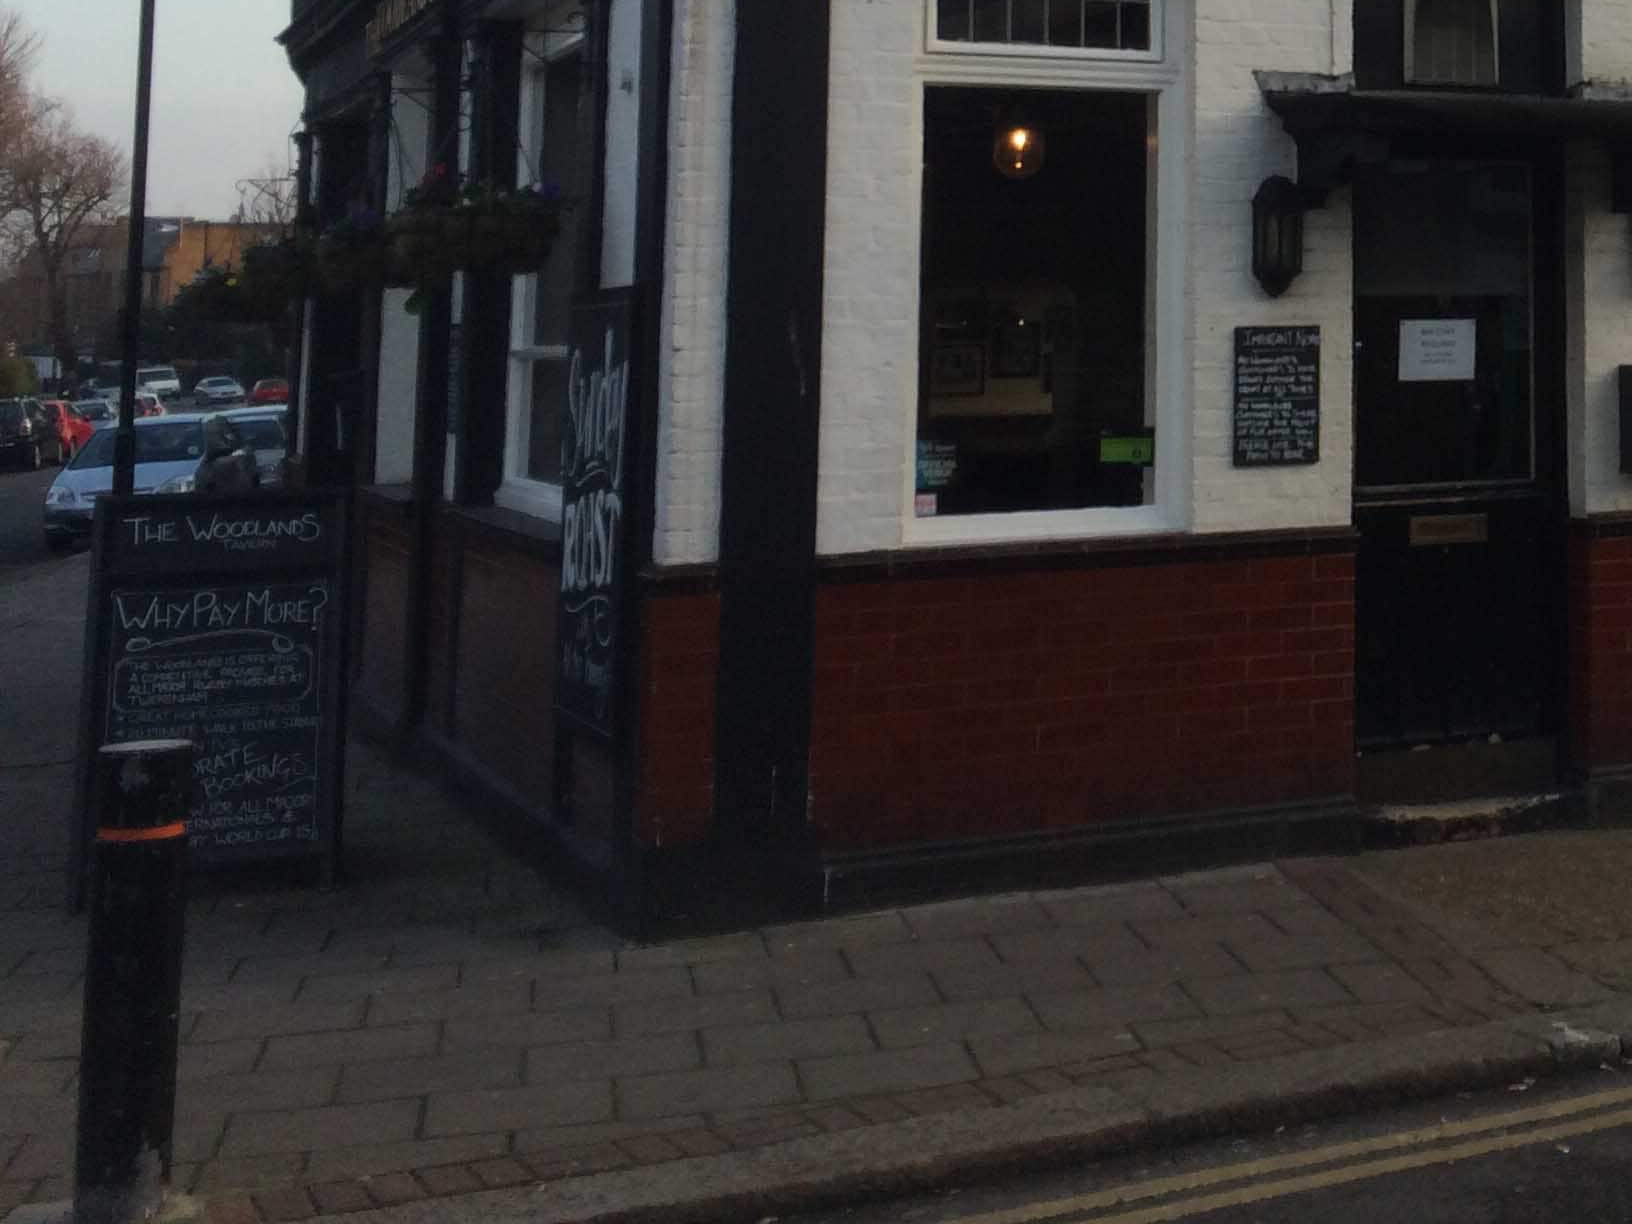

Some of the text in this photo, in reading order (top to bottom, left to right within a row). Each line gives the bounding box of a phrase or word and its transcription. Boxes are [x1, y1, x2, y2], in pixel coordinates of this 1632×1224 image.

[123, 512, 321, 545] THE WOODLANDS
[562, 487, 622, 593] ROAST
[115, 587, 329, 632] WHY PAY MORE?
